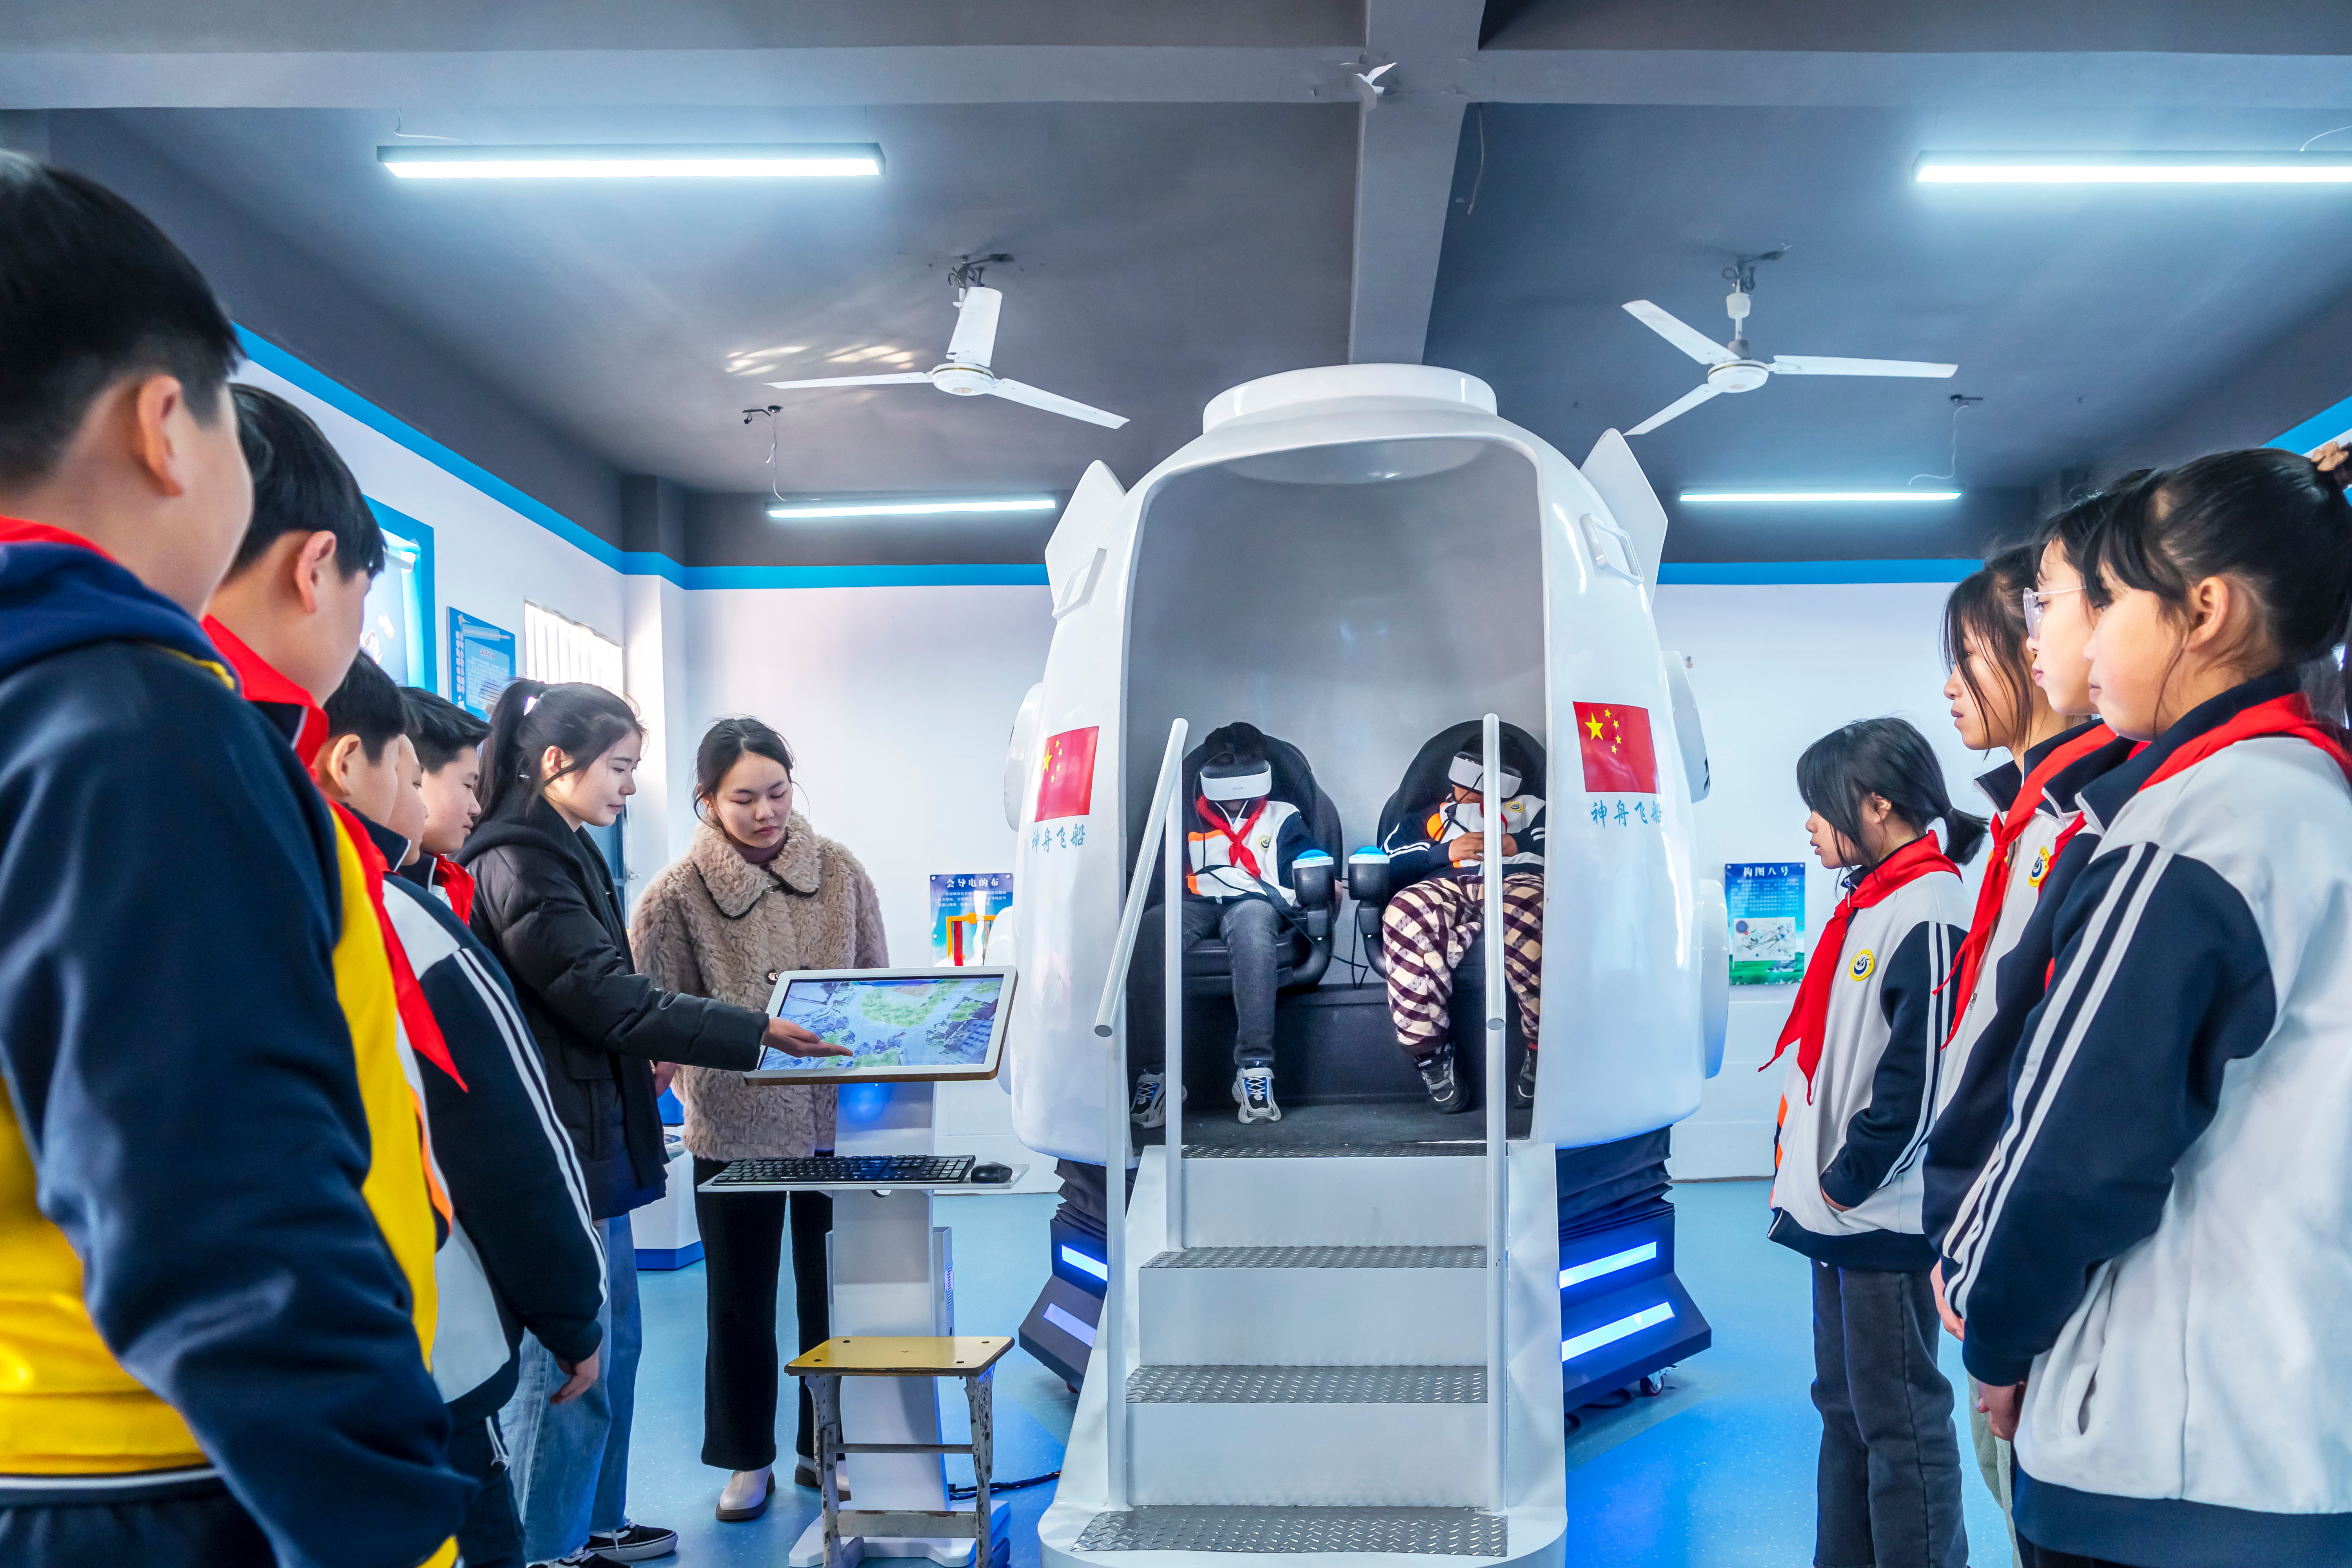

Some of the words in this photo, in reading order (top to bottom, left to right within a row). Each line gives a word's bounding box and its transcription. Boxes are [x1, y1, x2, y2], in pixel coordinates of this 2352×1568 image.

[1590, 799, 1662, 829] 神舟飞船
[1031, 823, 1085, 856] 神舟飞船
[1743, 866, 1789, 877] 构图八号
[946, 878, 999, 888] 会导电的布
